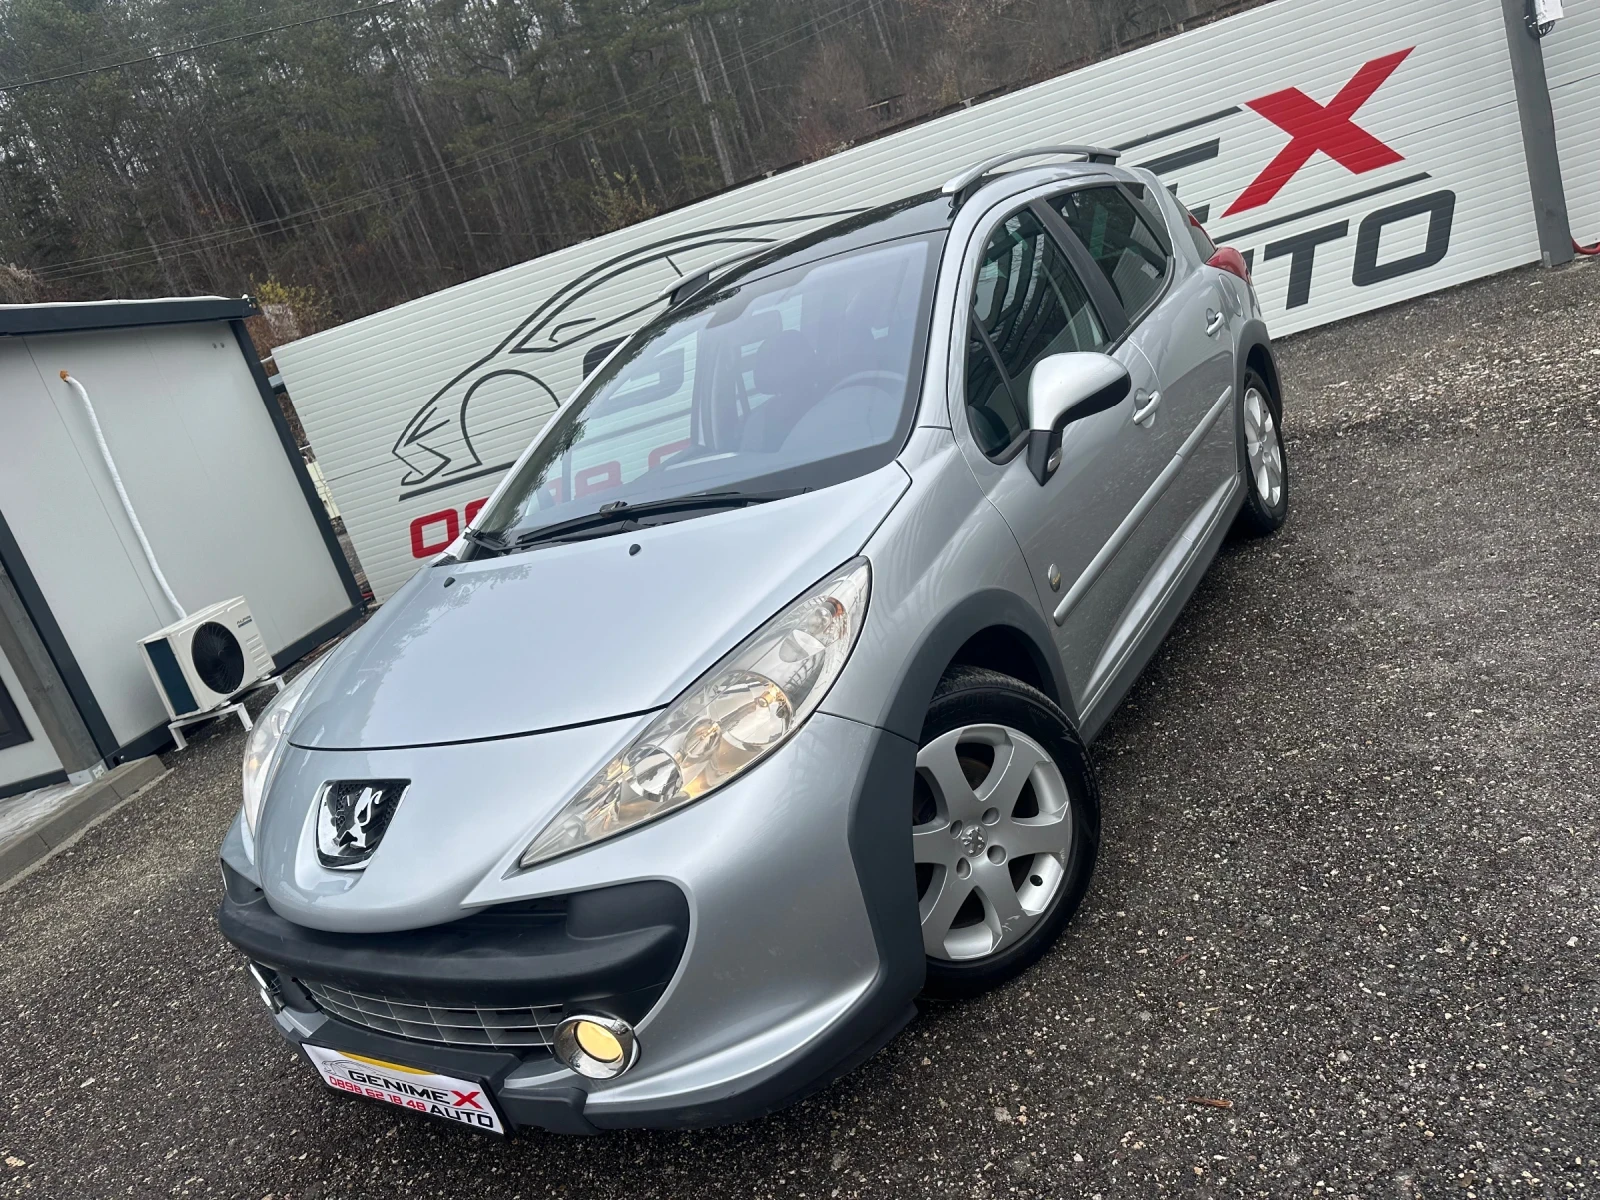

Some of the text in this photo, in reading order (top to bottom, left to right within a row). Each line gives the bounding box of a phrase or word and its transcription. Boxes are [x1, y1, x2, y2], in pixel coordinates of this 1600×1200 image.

[1241, 189, 1456, 311] TO
[329, 1076, 426, 1111] 0898 62 18 48
[348, 1070, 484, 1110] GENIMEX
[430, 1104, 494, 1128] AUTO
